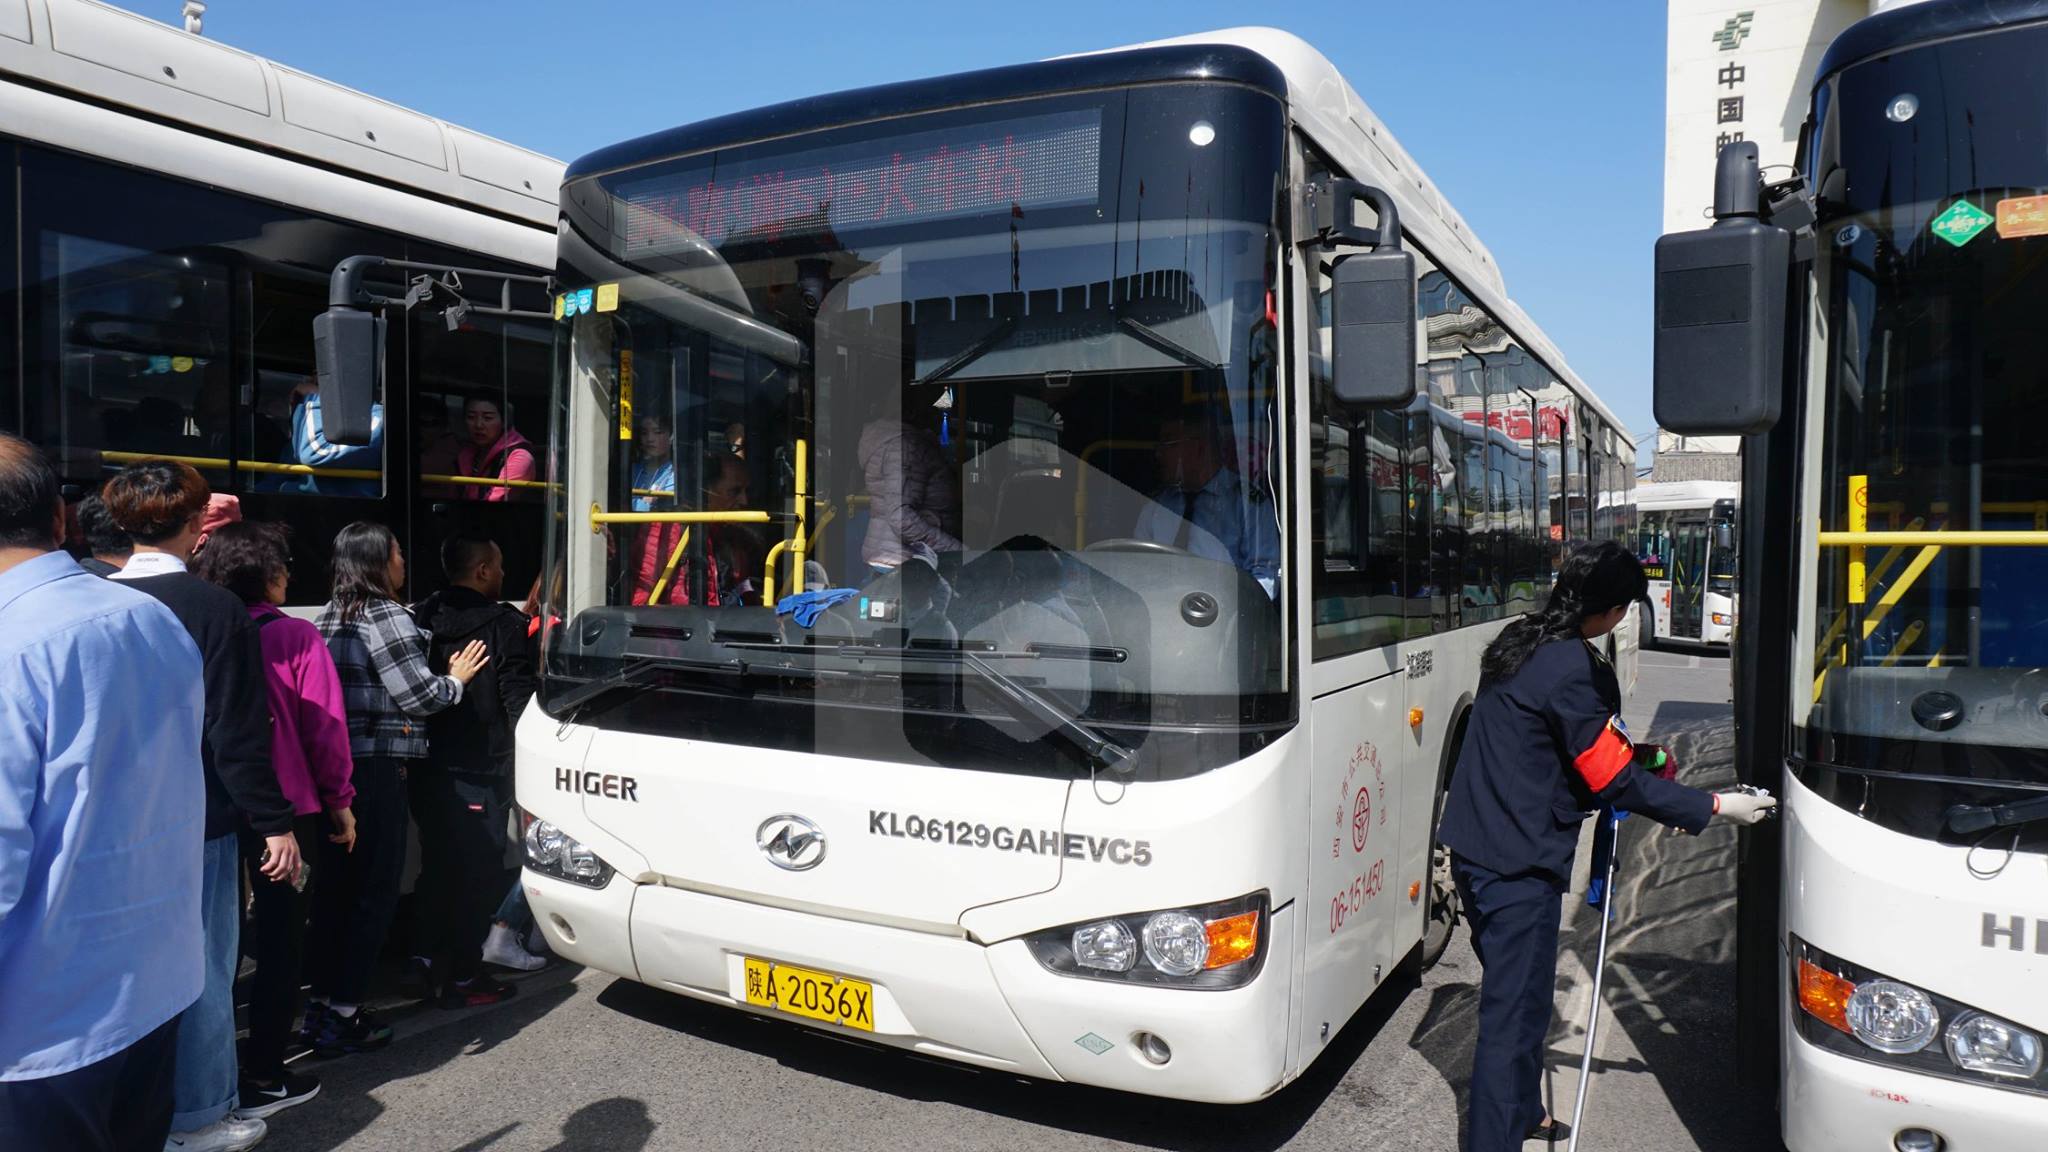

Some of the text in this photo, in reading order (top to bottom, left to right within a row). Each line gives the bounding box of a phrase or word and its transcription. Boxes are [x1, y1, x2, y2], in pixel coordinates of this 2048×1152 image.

[555, 766, 639, 803] HIGER
[868, 809, 1153, 867] KLQ6129GAHEVC5
[1329, 857, 1385, 934] 06-151450
